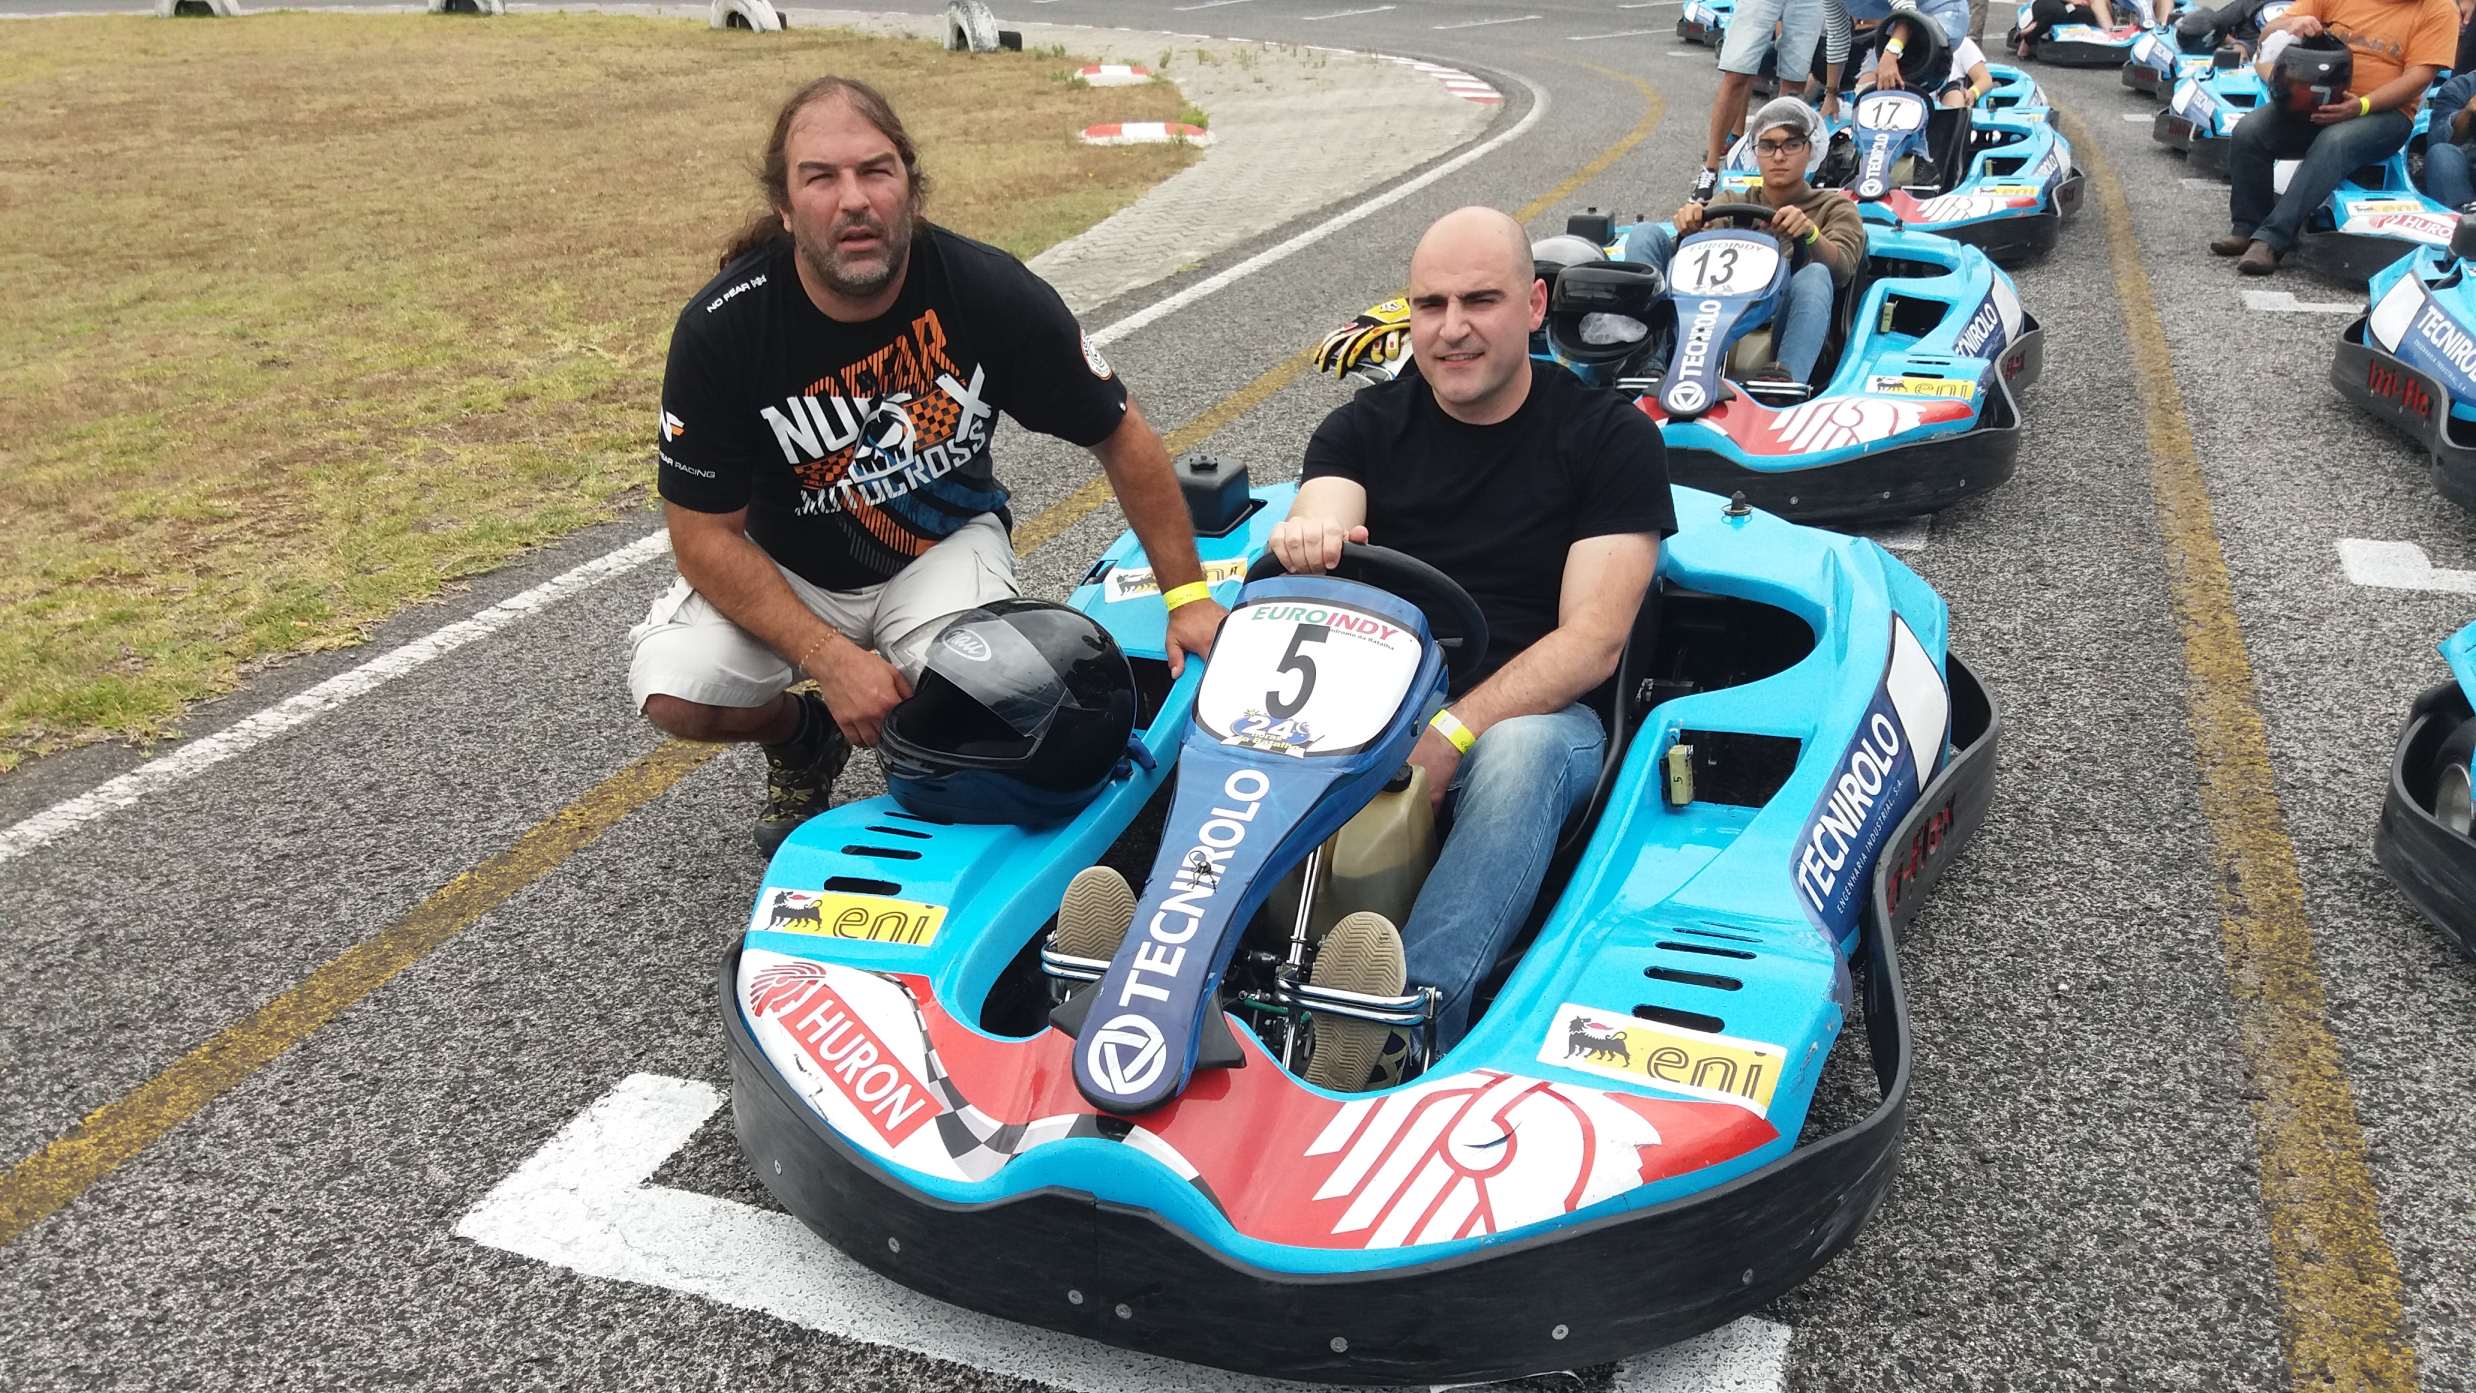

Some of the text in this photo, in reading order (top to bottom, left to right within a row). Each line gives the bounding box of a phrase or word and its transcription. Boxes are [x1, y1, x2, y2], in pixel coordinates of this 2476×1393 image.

[1873, 102, 1901, 126] 17
[2403, 215, 2453, 238] HURO
[1693, 248, 1738, 287] 13
[707, 282, 750, 312] NO FEAR
[2417, 305, 2476, 383] TECNIROL
[675, 460, 715, 479] RACING
[1251, 606, 1399, 641] EUROINDY
[1266, 623, 1331, 719] 5
[1241, 716, 1295, 738] 24
[1673, 776, 1683, 784] 5
[1799, 713, 1899, 912] TECNIROLO
[1119, 769, 1270, 1007] TECNIROLO
[1838, 853, 1868, 914] ENGENHARIA
[833, 905, 935, 945] eni
[795, 999, 926, 1131] HURON
[1647, 1047, 1766, 1100] eni
